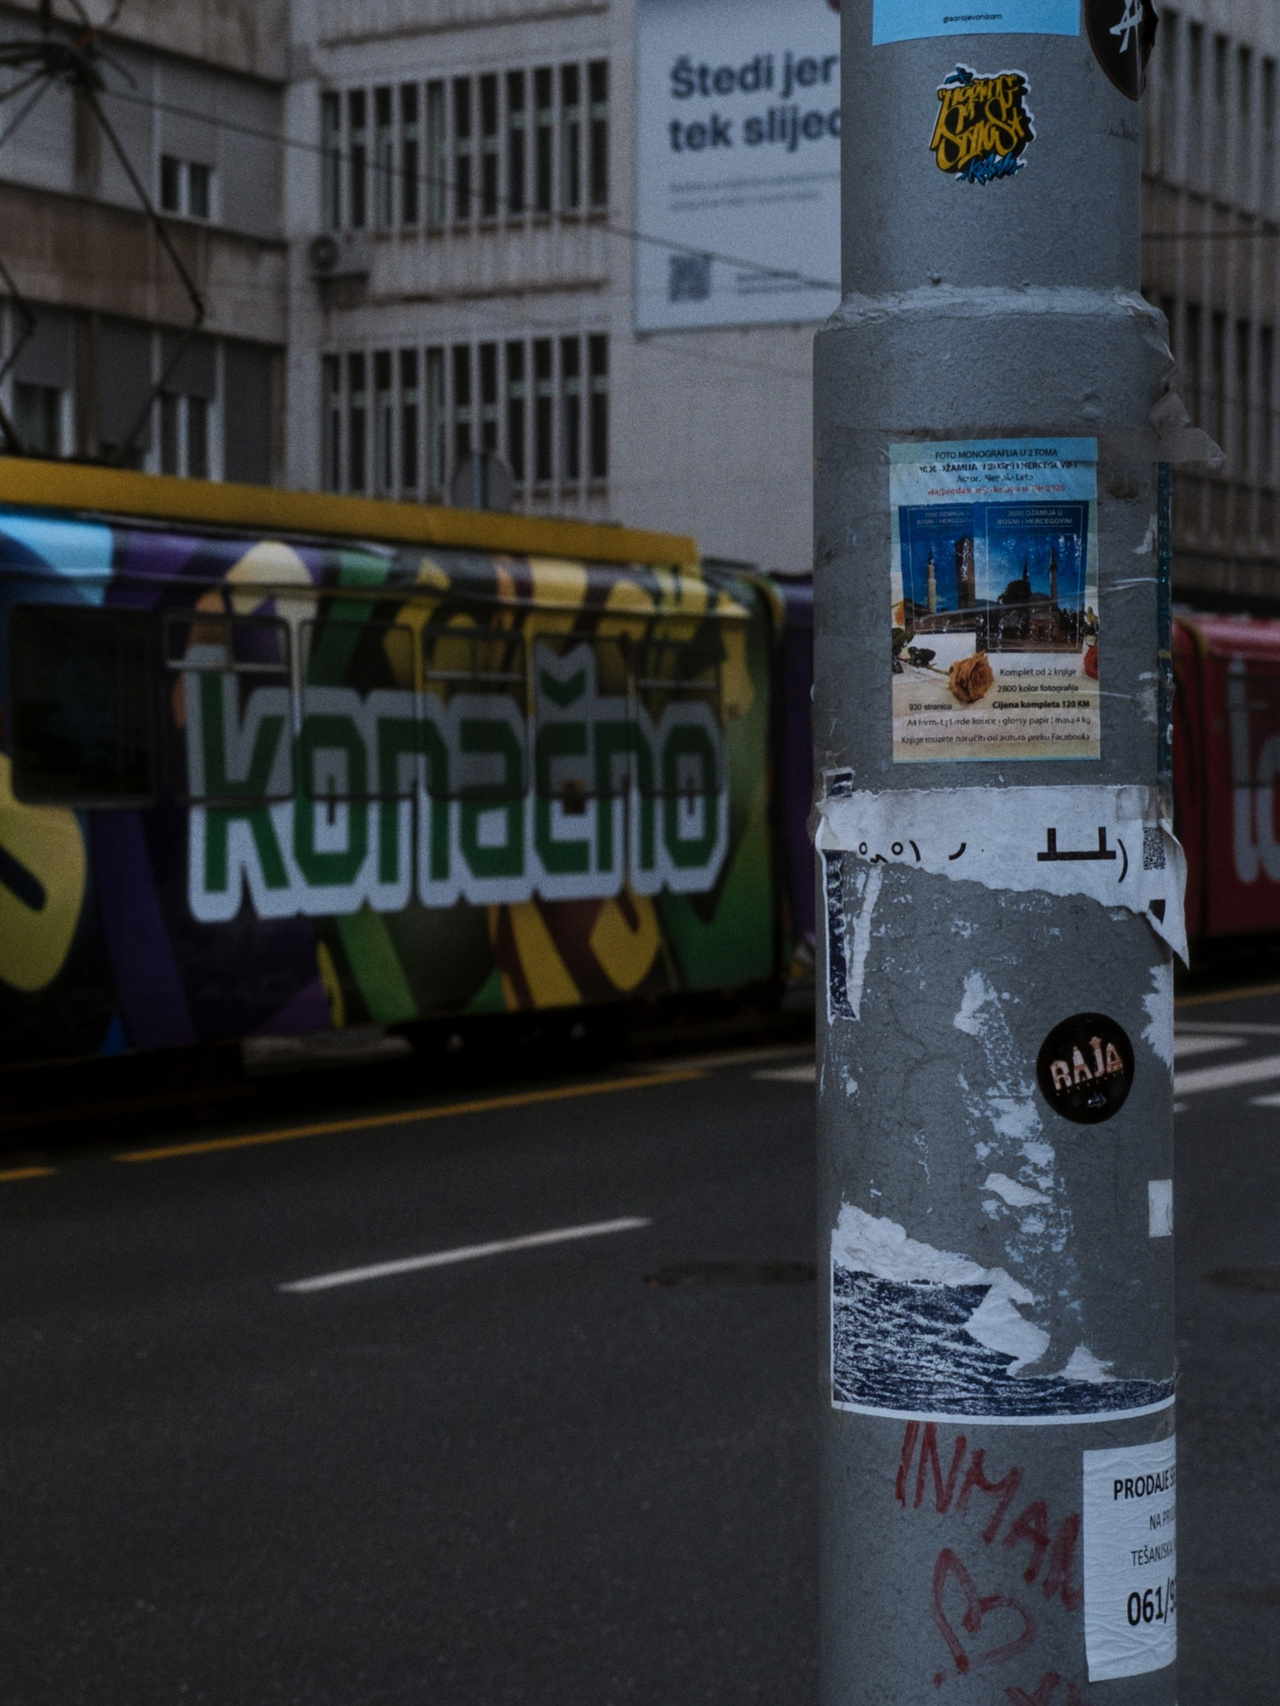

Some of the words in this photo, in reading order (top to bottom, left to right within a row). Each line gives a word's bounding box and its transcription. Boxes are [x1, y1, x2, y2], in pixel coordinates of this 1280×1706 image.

[671, 54, 774, 100] Štedi
[669, 112, 733, 153] tek
[935, 451, 957, 460] FOTO
[958, 449, 1018, 459] MONOGRAFIJA
[1020, 450, 1027, 458] U
[1028, 449, 1033, 457] 2
[1034, 448, 1058, 457] TOMA
[1024, 517, 1074, 525] HERCEGOVINI
[999, 668, 1034, 678] Komplet
[1035, 668, 1046, 676] od
[1047, 668, 1052, 676] 2
[1054, 668, 1077, 678] knjige
[997, 685, 1018, 693] 2800
[1019, 684, 1039, 693] kolor
[1040, 684, 1079, 694] fotografija
[923, 703, 953, 711] stranica
[992, 700, 1019, 710] Cijena
[1020, 700, 1060, 710] kompleta
[1061, 700, 1076, 708] 120
[1077, 700, 1090, 708] KM
[1029, 717, 1050, 727] papir
[901, 736, 924, 746] Knjige
[1048, 1034, 1125, 1092] RAJA
[1113, 1470, 1170, 1501] PRODAJE
[1149, 1513, 1162, 1531] NA
[1127, 1577, 1177, 1627] 061/9
